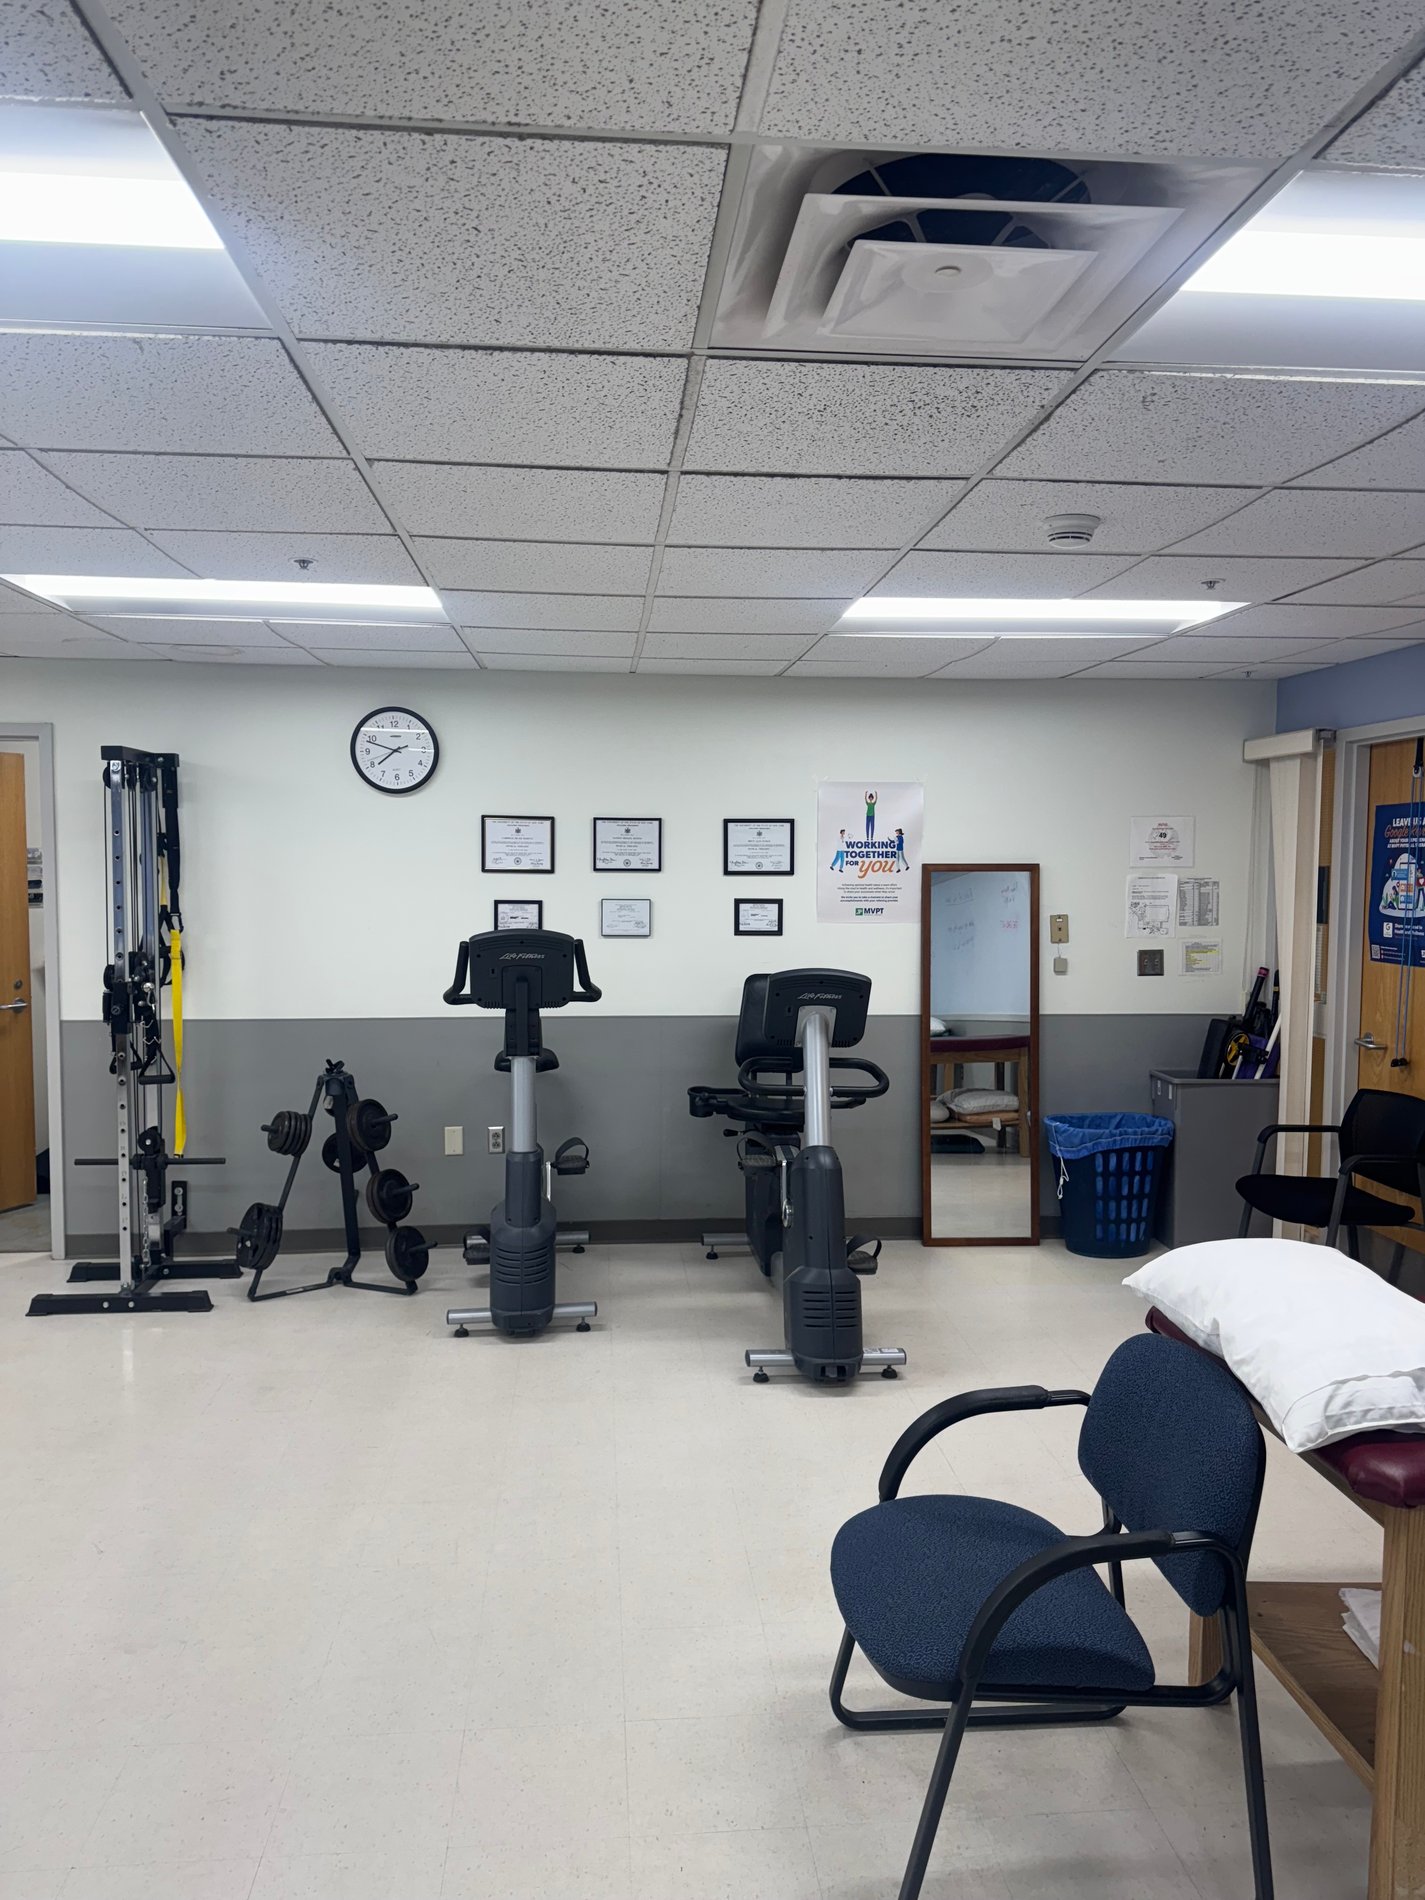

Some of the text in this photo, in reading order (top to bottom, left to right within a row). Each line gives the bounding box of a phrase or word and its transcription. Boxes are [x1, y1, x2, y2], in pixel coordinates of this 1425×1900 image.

[1392, 818, 1411, 826] LEAVE
[1385, 825, 1408, 838] Google
[858, 860, 896, 879] you
